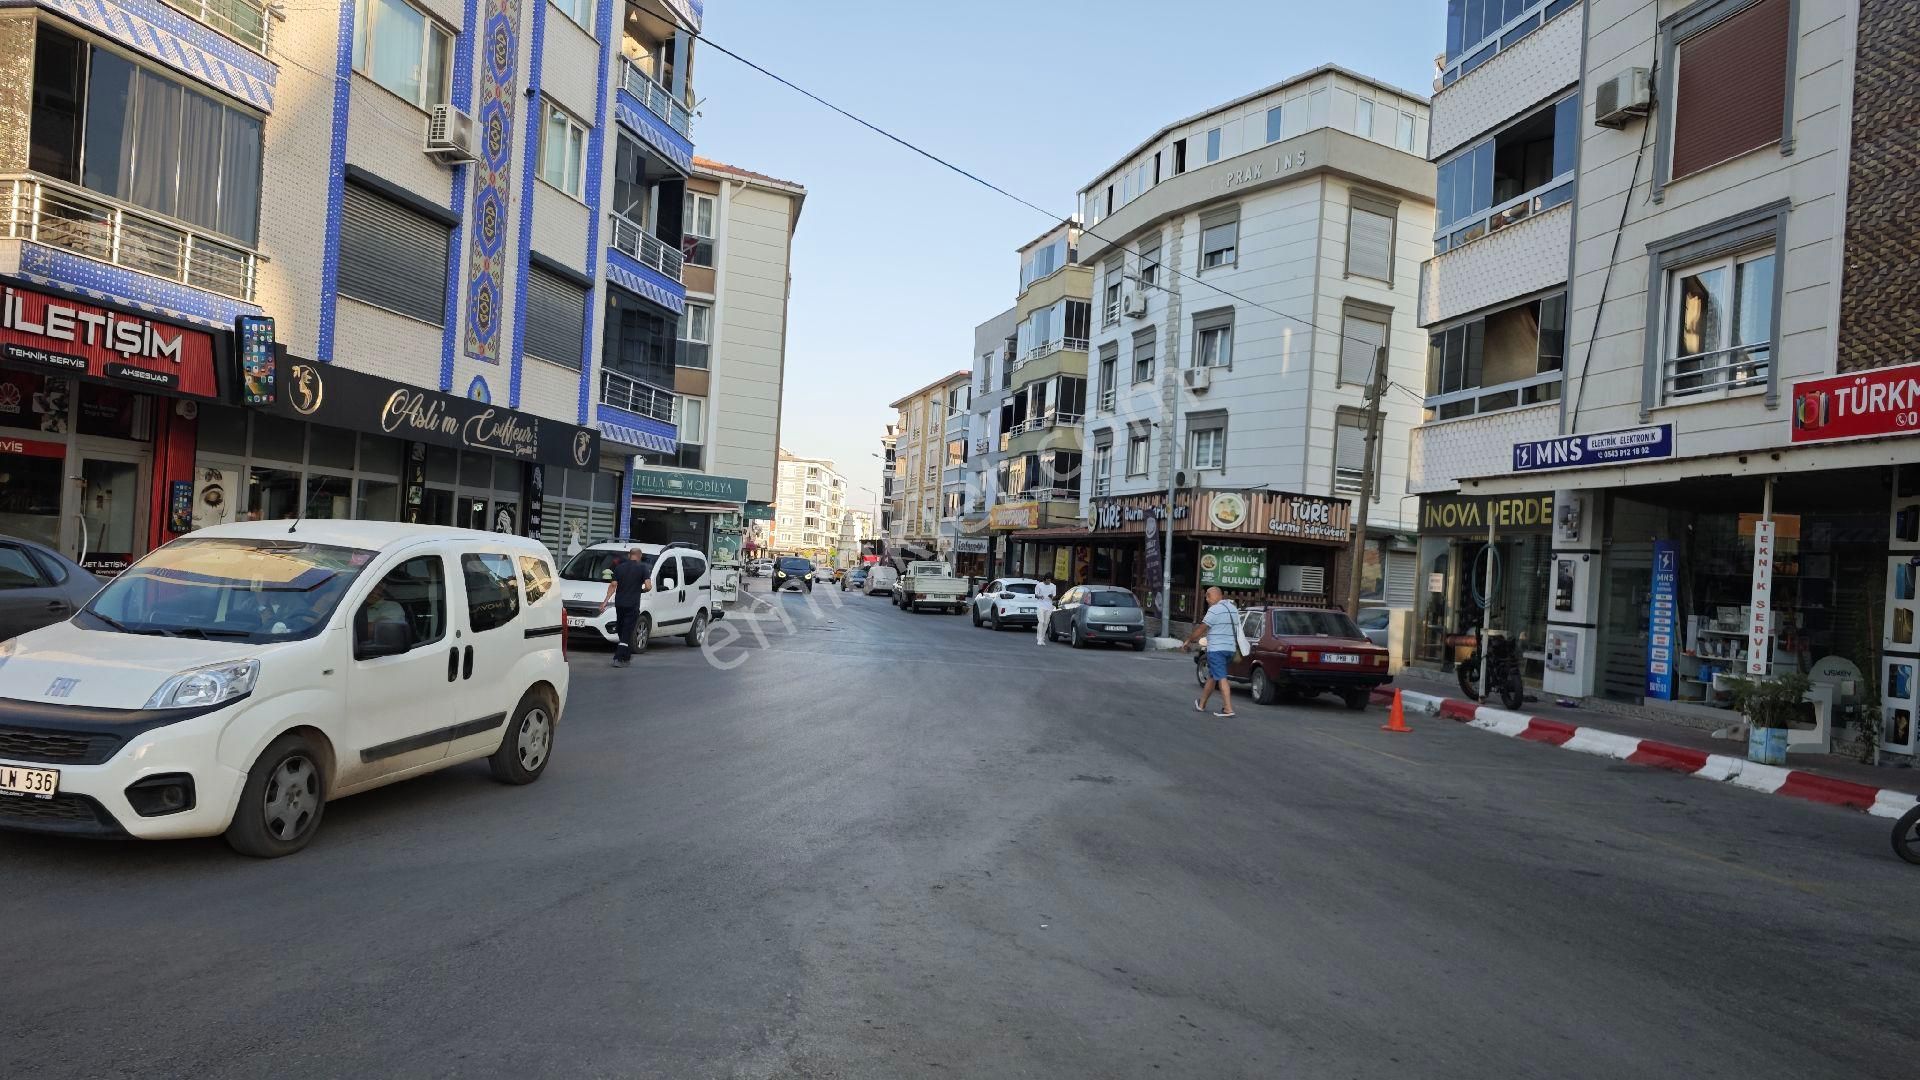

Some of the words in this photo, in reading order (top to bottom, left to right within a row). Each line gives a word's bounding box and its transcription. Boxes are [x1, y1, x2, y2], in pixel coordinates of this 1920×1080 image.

[4, 288, 182, 362] İLETİŞİM
[9, 347, 47, 361] TEKNİK
[49, 355, 85, 368] SERVİS
[120, 368, 169, 383] AKSESUAR
[463, 408, 534, 447] Coiffeur
[1536, 438, 1582, 465] MNS
[1591, 436, 1616, 449] ELEKTRİK
[687, 479, 732, 493] MOBİLYA
[1098, 503, 1121, 529] TÜRE
[1125, 506, 1144, 521] Gurm
[1290, 502, 1329, 524] TÜRE
[1425, 500, 1480, 528] İNOVA
[1487, 497, 1552, 526] PERDE
[1222, 565, 1239, 574] SÜT
[1223, 554, 1259, 564] GÜNLÜK
[1222, 576, 1261, 586] BULUNUR
[1752, 599, 1765, 673] SERVİS
[26, 772, 53, 792] 536
